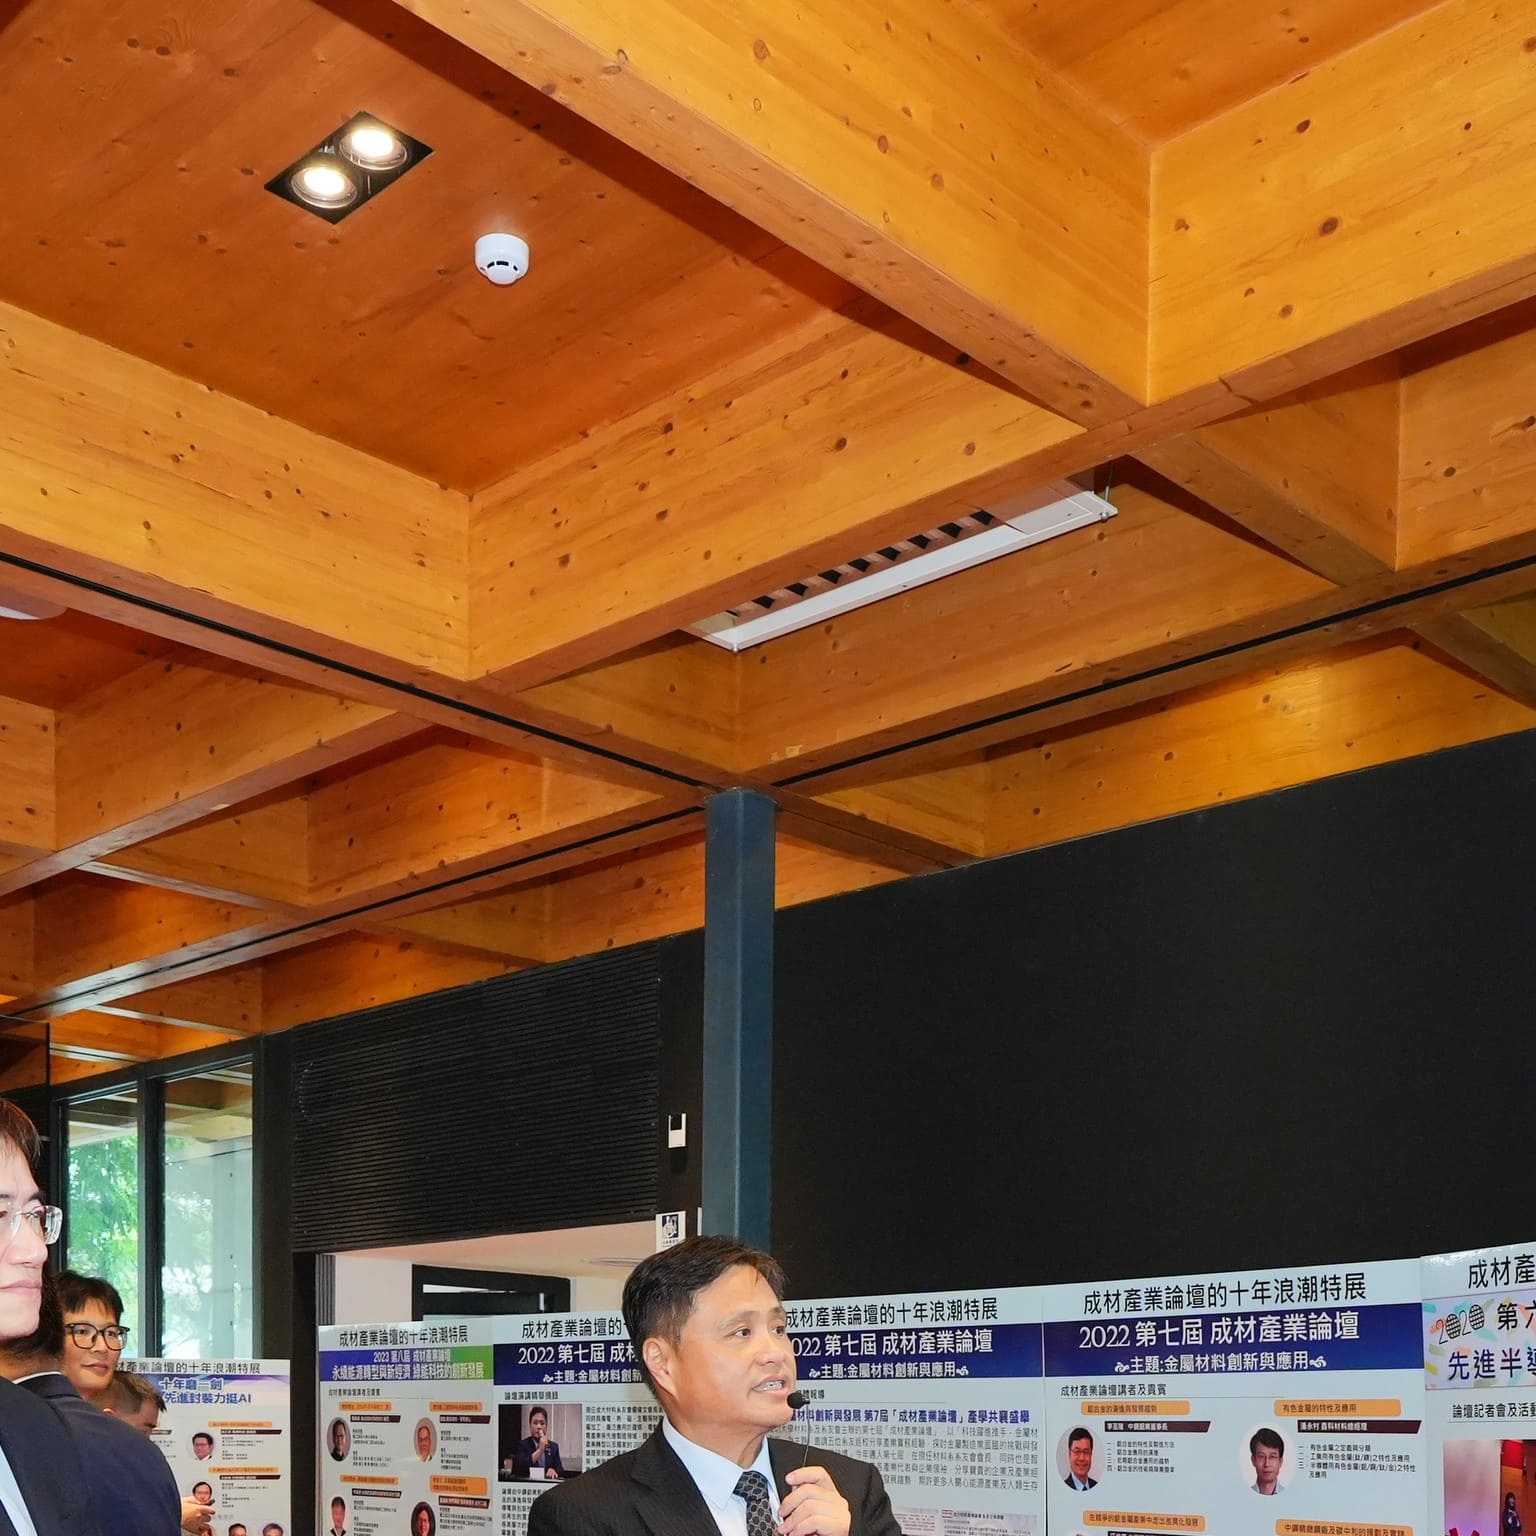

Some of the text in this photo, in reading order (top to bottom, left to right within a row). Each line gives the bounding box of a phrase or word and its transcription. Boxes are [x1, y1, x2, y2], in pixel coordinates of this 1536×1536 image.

[1083, 1272, 1366, 1316] 成材產業論壇的十年浪潮特展
[787, 1297, 998, 1328] 成材產業論壇的十年浪潮特展
[339, 1325, 468, 1347] 成材產業論壇的十年浪潮特展
[522, 1317, 630, 1339] 成材產業論壇的
[1079, 1310, 1360, 1349] 2022 第七屆 成材產業論壇
[825, 1334, 876, 1356] 第七屆
[882, 1328, 993, 1355] 成材產業論壇
[373, 1351, 390, 1363] 2023
[518, 1347, 555, 1364] 2022
[558, 1344, 605, 1364] 第七屆
[1130, 1350, 1309, 1374] 主題:金屬材料創新與應用
[1060, 1383, 1167, 1397] 成材產業論壇講者及貴賓
[1282, 1403, 1357, 1413] 有色金屬的特性及應用
